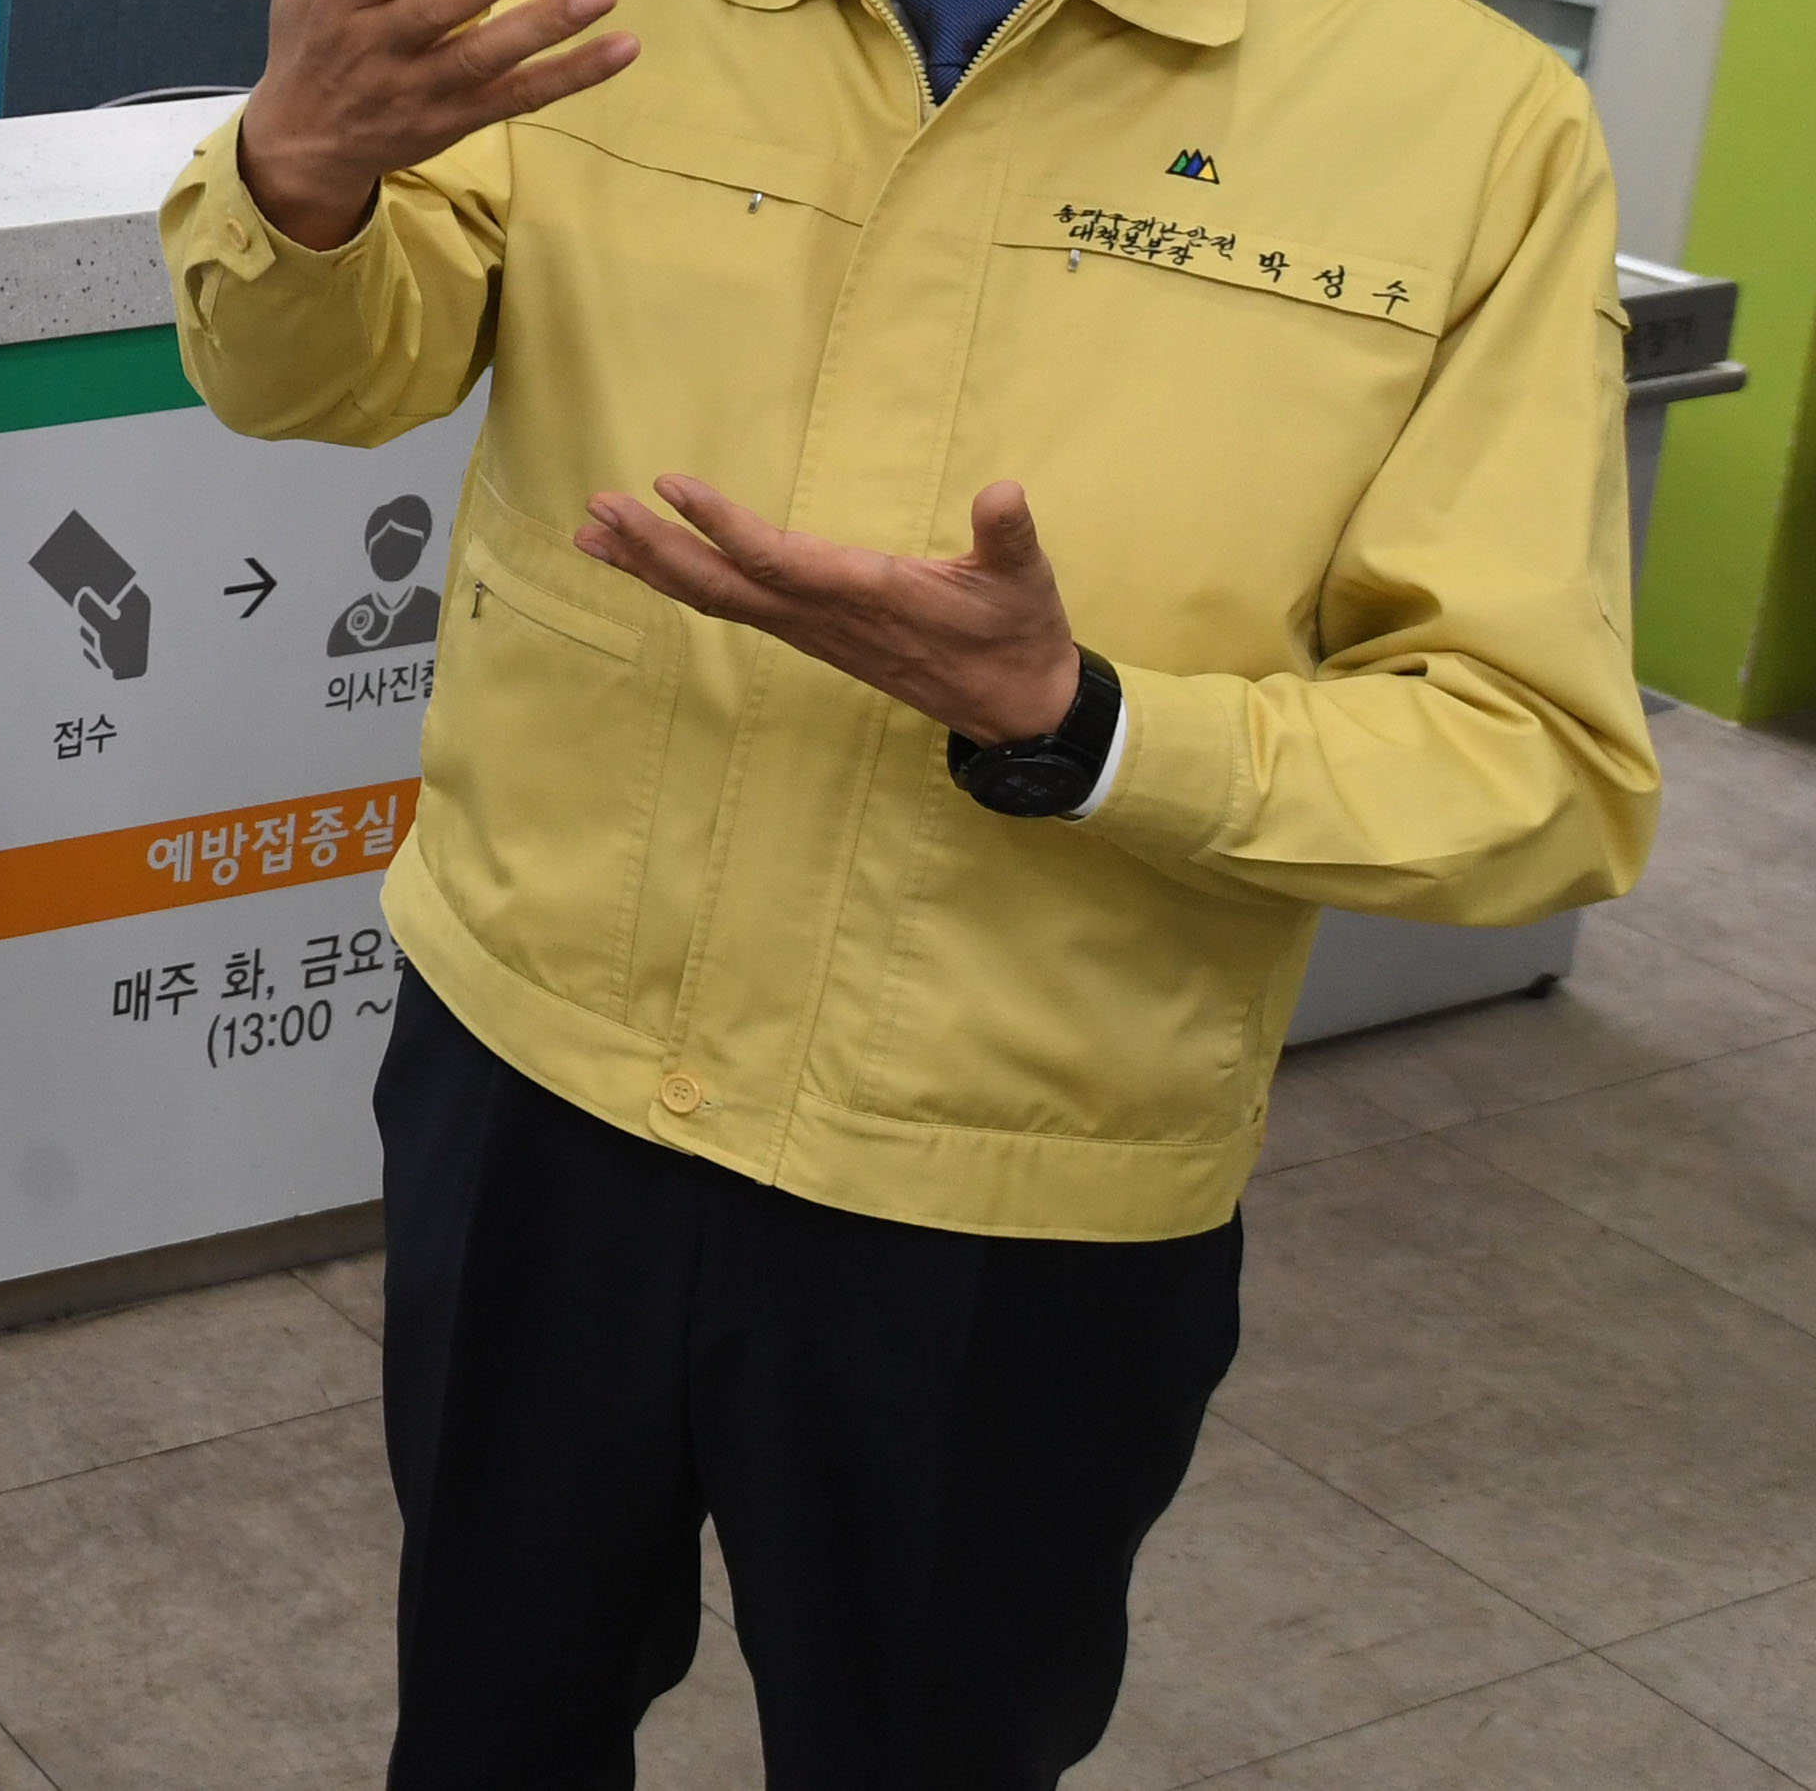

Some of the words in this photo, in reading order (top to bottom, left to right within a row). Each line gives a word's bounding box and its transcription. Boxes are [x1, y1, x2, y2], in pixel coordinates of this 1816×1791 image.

[52, 714, 118, 759] 접수
[147, 795, 399, 886] 예방접종실
[112, 960, 199, 1022] 매주
[221, 946, 276, 1002] 화,
[206, 996, 333, 1068] (13:00
